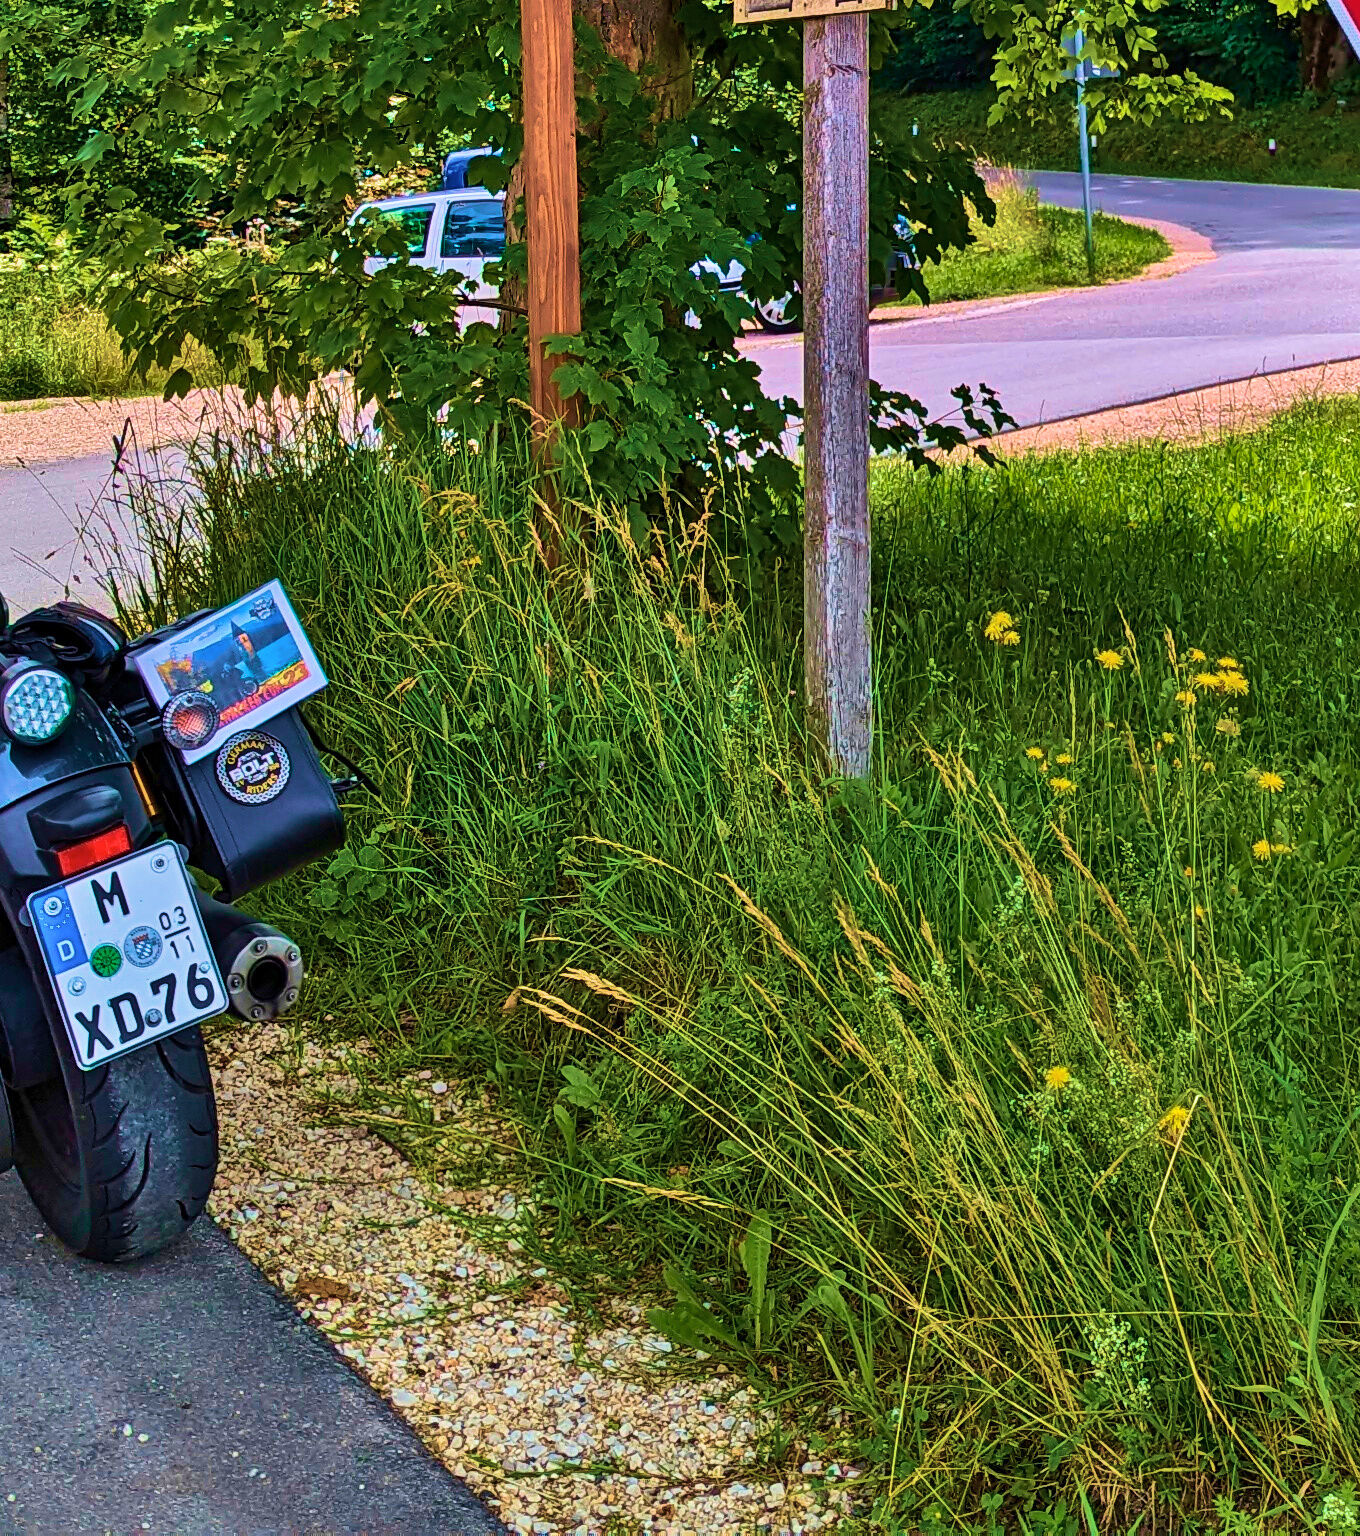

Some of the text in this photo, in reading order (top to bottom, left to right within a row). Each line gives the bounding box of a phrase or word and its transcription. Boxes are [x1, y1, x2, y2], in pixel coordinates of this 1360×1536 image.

[227, 740, 266, 765] GERMAN
[229, 752, 274, 782] BOLT
[246, 773, 278, 794] RIDERS
[90, 871, 130, 924] M
[159, 905, 187, 931] 03
[57, 939, 75, 961] D
[170, 934, 195, 959] 11
[74, 962, 215, 1059] XD 76
